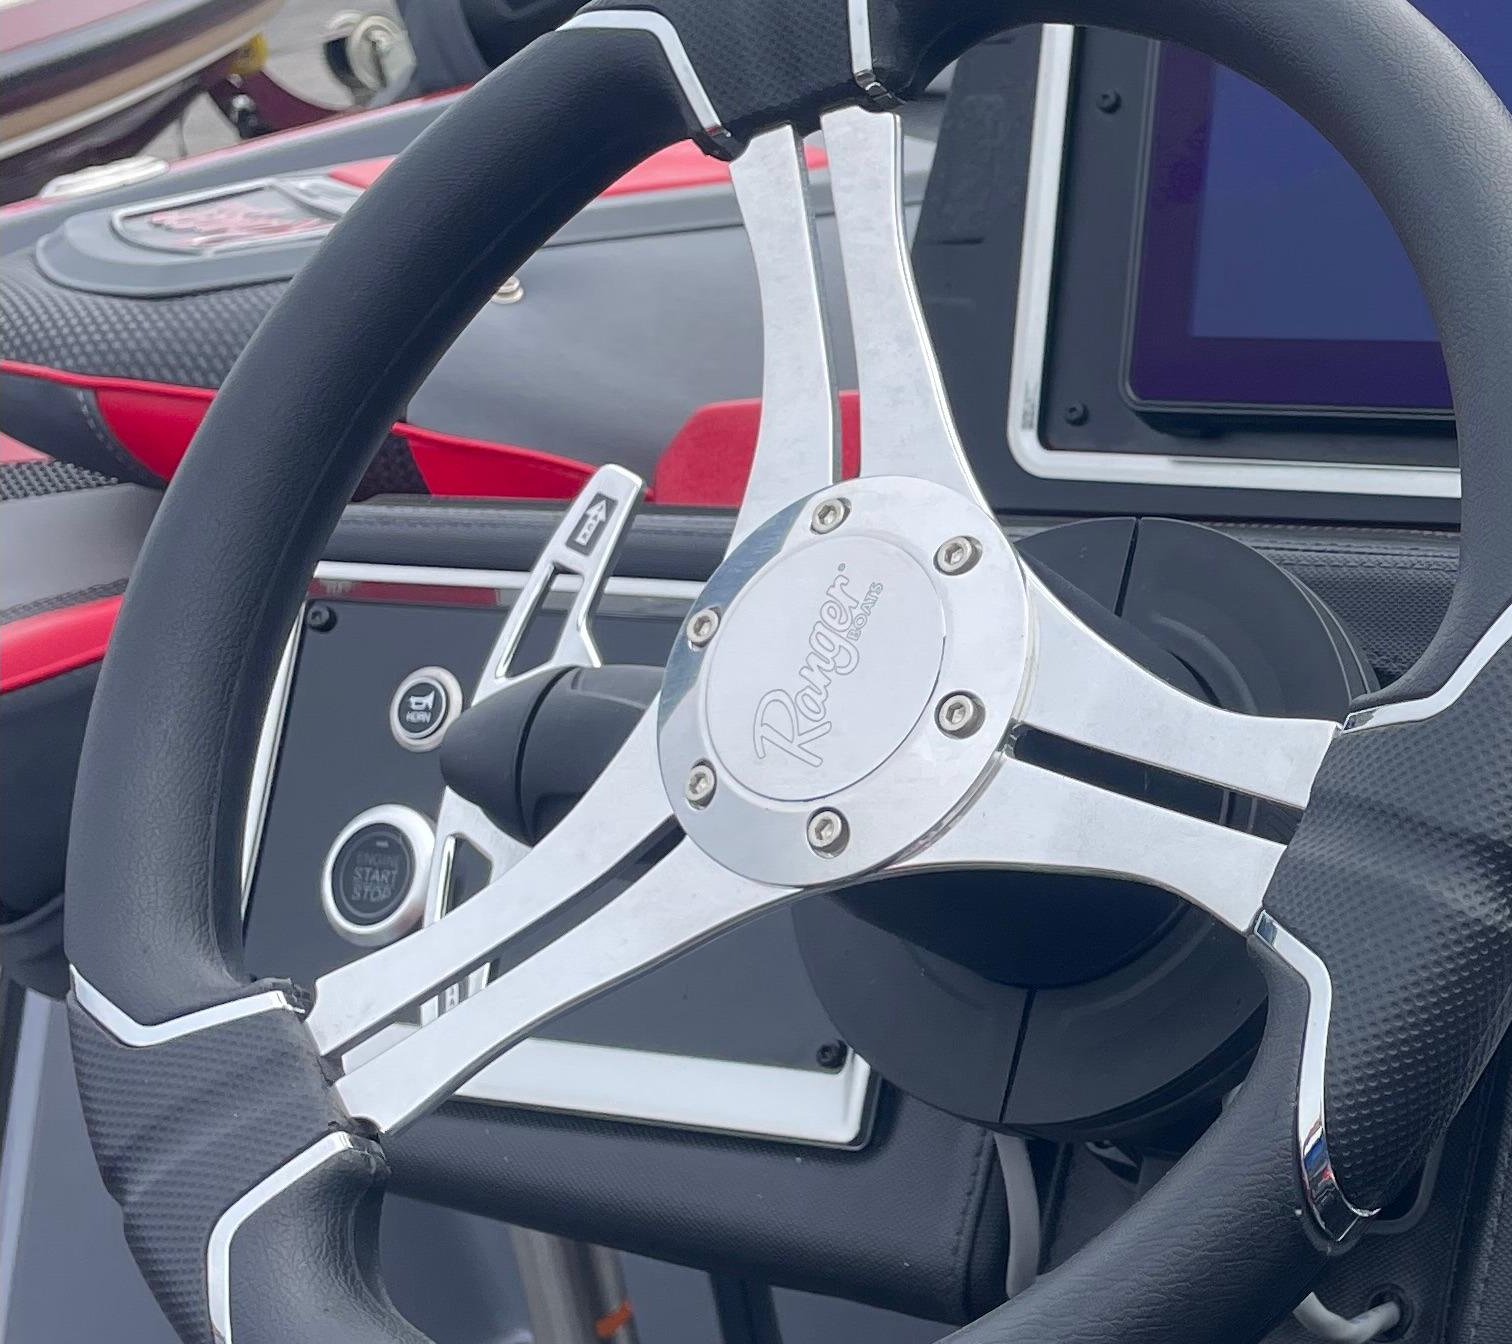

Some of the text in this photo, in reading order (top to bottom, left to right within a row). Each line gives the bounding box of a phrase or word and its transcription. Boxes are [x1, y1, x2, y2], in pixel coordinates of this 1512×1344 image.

[848, 581, 883, 642] BOATS
[753, 573, 860, 768] Ranger
[405, 711, 432, 724] HORN
[352, 867, 399, 883] START
[351, 887, 392, 903] STOP
